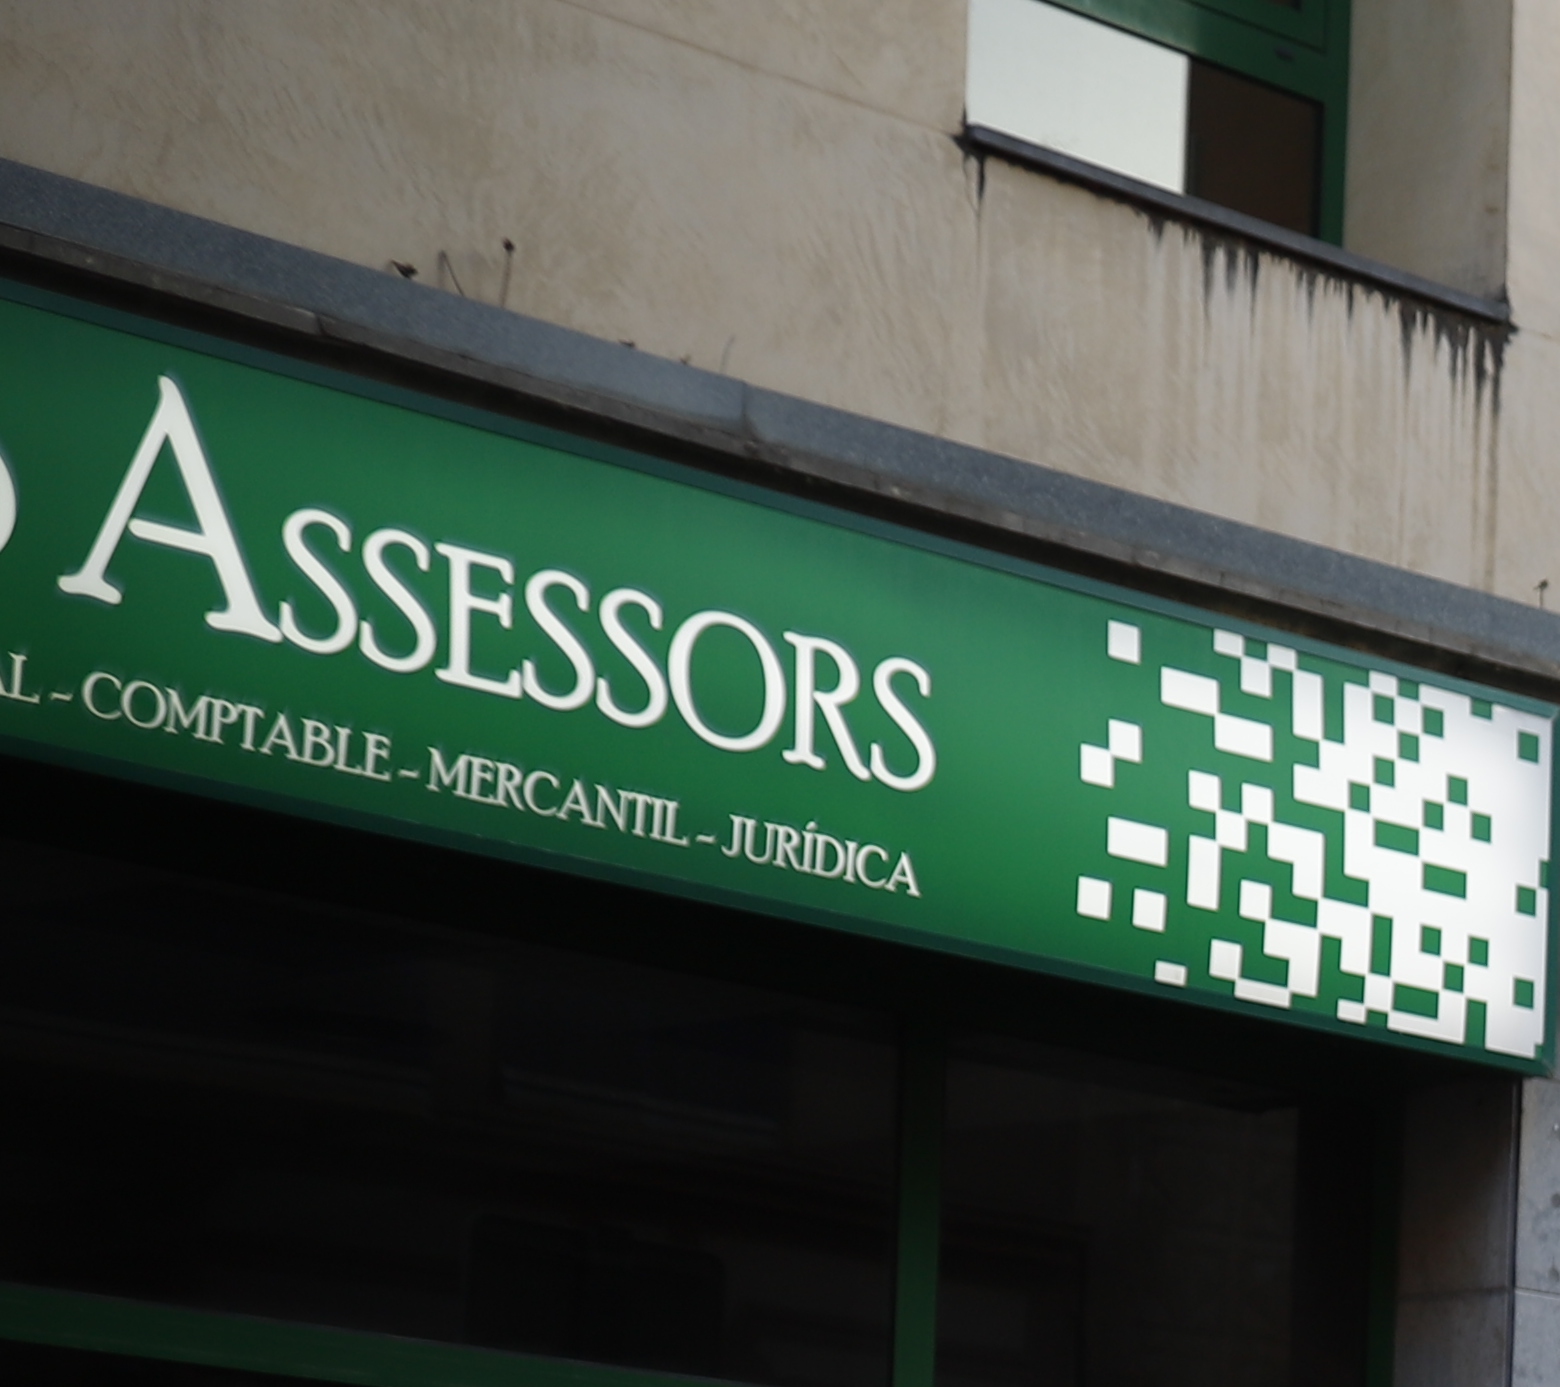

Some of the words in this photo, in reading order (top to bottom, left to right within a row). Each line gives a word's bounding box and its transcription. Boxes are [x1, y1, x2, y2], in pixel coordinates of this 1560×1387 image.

[81, 670, 392, 782] COMPTABLE
[426, 746, 689, 848] MERCANTIL
[720, 819, 922, 898] JURÍDICA
